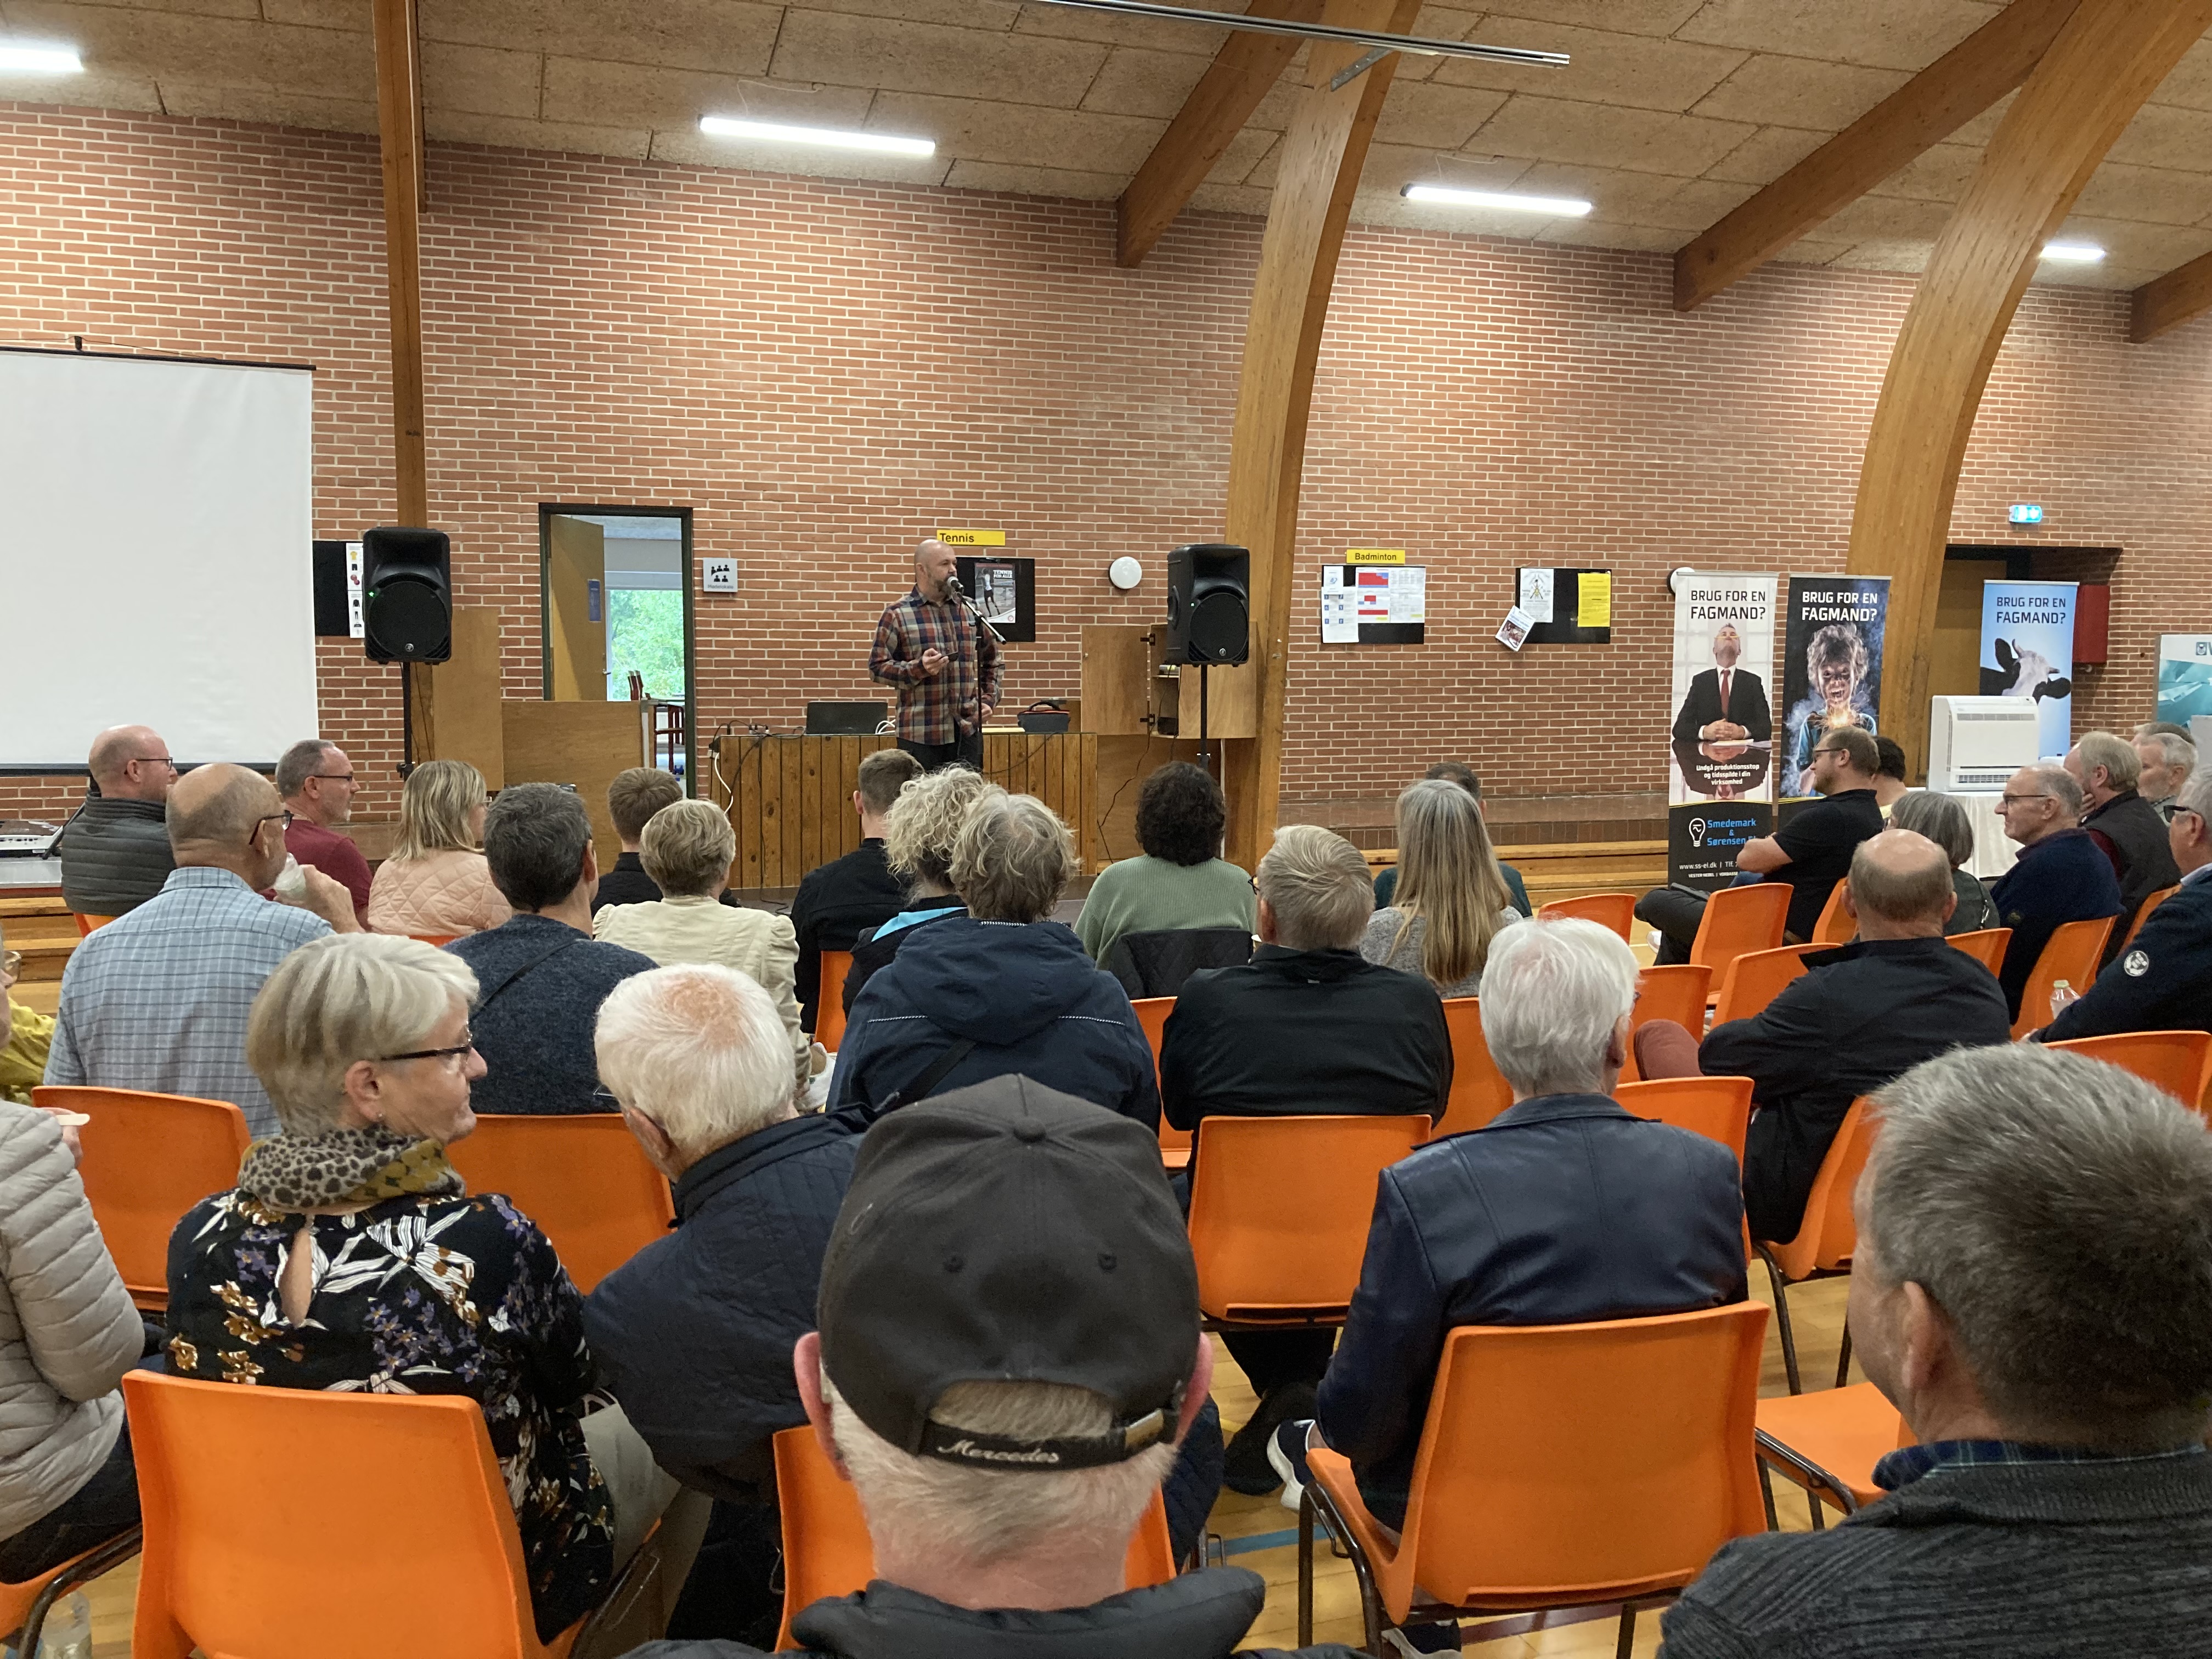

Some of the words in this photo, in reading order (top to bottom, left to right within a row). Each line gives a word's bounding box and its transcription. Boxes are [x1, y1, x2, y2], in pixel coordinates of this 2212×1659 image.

[939, 533, 974, 543] Tennis
[1355, 552, 1397, 561] Badminton
[1691, 590, 1722, 601] BRUG
[1725, 591, 1747, 601] FOR
[1751, 591, 1765, 601] EN
[1802, 591, 1833, 603] BRUG
[1837, 592, 1859, 603] FOR
[1863, 593, 1877, 603] EN
[1996, 597, 2025, 607] BRUG
[2029, 597, 2049, 607] FOR
[2052, 598, 2066, 607] EN
[1691, 606, 1766, 619] FAGMAND?
[1802, 607, 1877, 621] FAGMAND?
[1996, 611, 2066, 624] FAGMAND?
[1696, 764, 1713, 772] Undgå
[1707, 818, 1756, 828] Smedemark
[1707, 837, 1746, 846] Sørensen
[1679, 861, 1717, 870] www.ss-el.dk
[936, 1438, 1060, 1464] Mercedes
